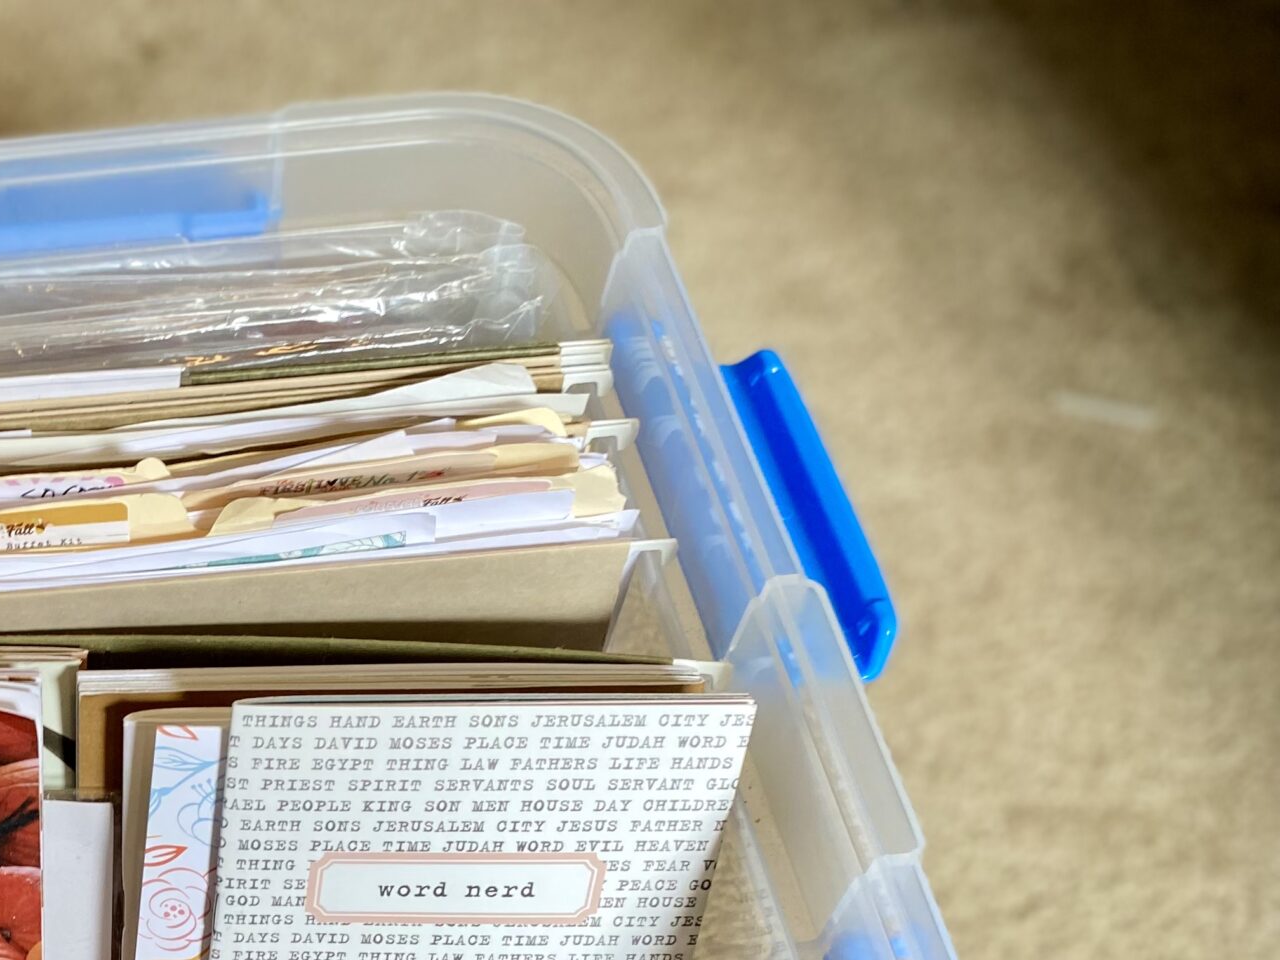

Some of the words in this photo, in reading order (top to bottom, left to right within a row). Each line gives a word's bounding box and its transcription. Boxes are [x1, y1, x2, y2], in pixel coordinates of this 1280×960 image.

[6, 522, 35, 538] Fall
[60, 537, 83, 547] Kit
[242, 715, 317, 728] THINGS
[329, 716, 381, 728] HAND
[392, 716, 457, 728] EARTH
[469, 714, 518, 728] SONS
[531, 714, 647, 728] JERUSALEM
[659, 714, 709, 726] CITY
[252, 736, 302, 749] DAYS
[314, 737, 378, 750] DAVID
[389, 737, 452, 749] MOSES
[463, 736, 528, 749] PLACE
[540, 736, 590, 749] TIME
[602, 736, 666, 749] JUDAH
[678, 736, 726, 748] WORD
[252, 758, 300, 770] FIRE
[311, 758, 374, 770] EGYPT
[386, 758, 448, 770] THING
[460, 758, 499, 770] LAW
[510, 758, 598, 770] FATHERS
[608, 758, 660, 770] LIFE
[670, 757, 733, 770] HANDS
[260, 779, 335, 791] PRIEST
[348, 780, 422, 791] SPIRIT
[434, 779, 534, 791] SERVANTS
[546, 778, 595, 791] SOUL
[608, 778, 694, 790] SERVANT
[277, 800, 351, 812] PEOPLE
[362, 801, 412, 812] KING
[424, 800, 462, 812] SON
[472, 800, 510, 812] MEN
[520, 800, 583, 812] HOUSE
[593, 800, 632, 812] DAY
[240, 819, 301, 832] EARTH
[313, 820, 360, 832] SONS
[373, 820, 484, 832] JERUSALEM
[497, 820, 546, 832] CITY
[556, 820, 618, 832] JESUS
[630, 820, 703, 832] FATHER
[238, 839, 298, 851] MOSES
[310, 840, 370, 852] PLACE
[383, 841, 431, 852] TIME
[442, 841, 504, 852] JUDAH
[516, 840, 564, 852] WORD
[574, 840, 624, 852] EVIL
[634, 840, 709, 852] HEAVEN
[236, 859, 296, 870] THING
[643, 860, 691, 872] FEAR
[378, 882, 447, 897] word
[465, 882, 534, 897] nerd
[616, 880, 677, 891] PEACE
[226, 895, 260, 906] GOD
[636, 896, 697, 908] HOUSE
[224, 914, 294, 925] THINGS
[613, 916, 660, 927] CITY
[233, 932, 279, 943] DAYS
[291, 933, 350, 944] DAVID
[361, 934, 419, 945] MOSES
[430, 935, 490, 945] PLACE
[502, 936, 549, 946] TIME
[560, 935, 620, 946] JUDAH
[632, 935, 677, 946] WORD
